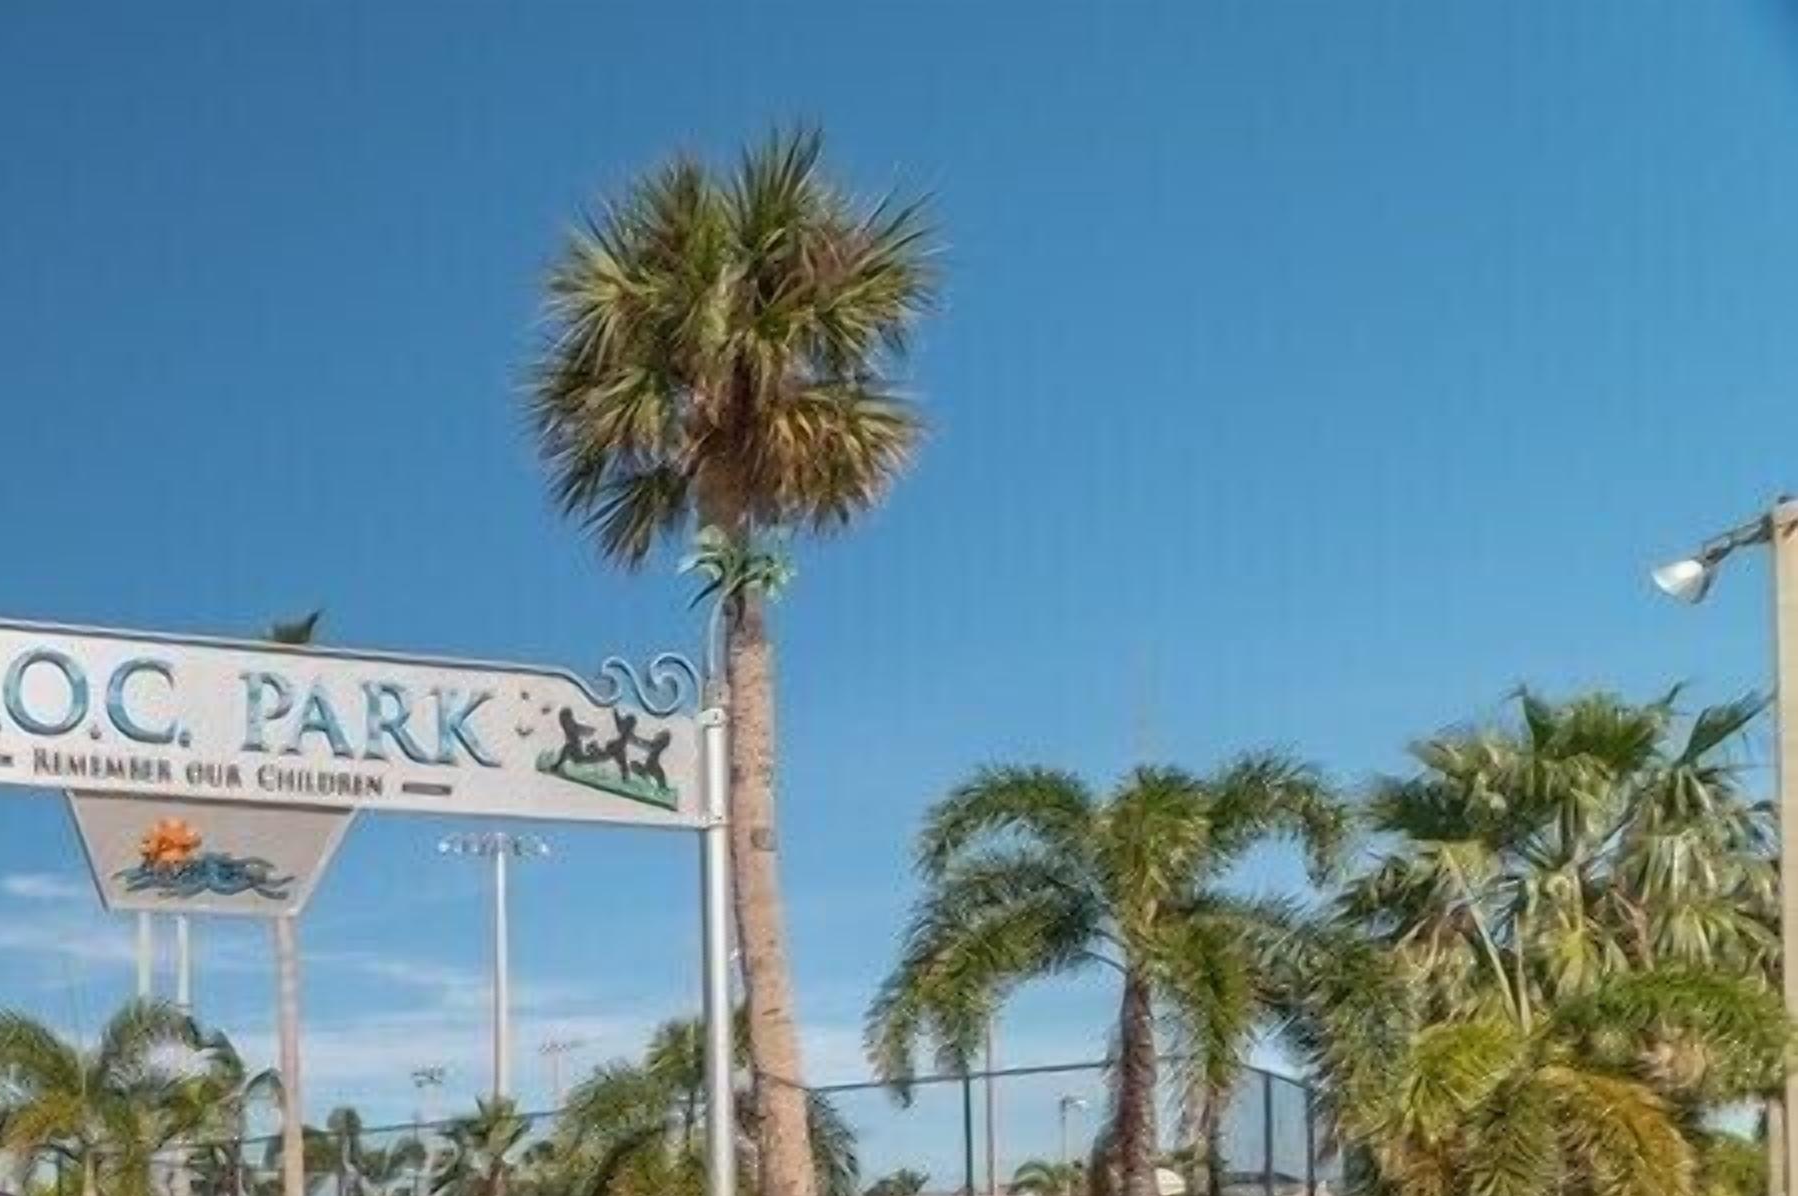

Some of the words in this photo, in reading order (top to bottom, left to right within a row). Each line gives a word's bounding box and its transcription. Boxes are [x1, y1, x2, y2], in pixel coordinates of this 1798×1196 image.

[239, 669, 502, 768] PARK
[33, 746, 173, 782] REMEMBER
[185, 761, 242, 789] OUR
[257, 763, 384, 796] CHILDREN
